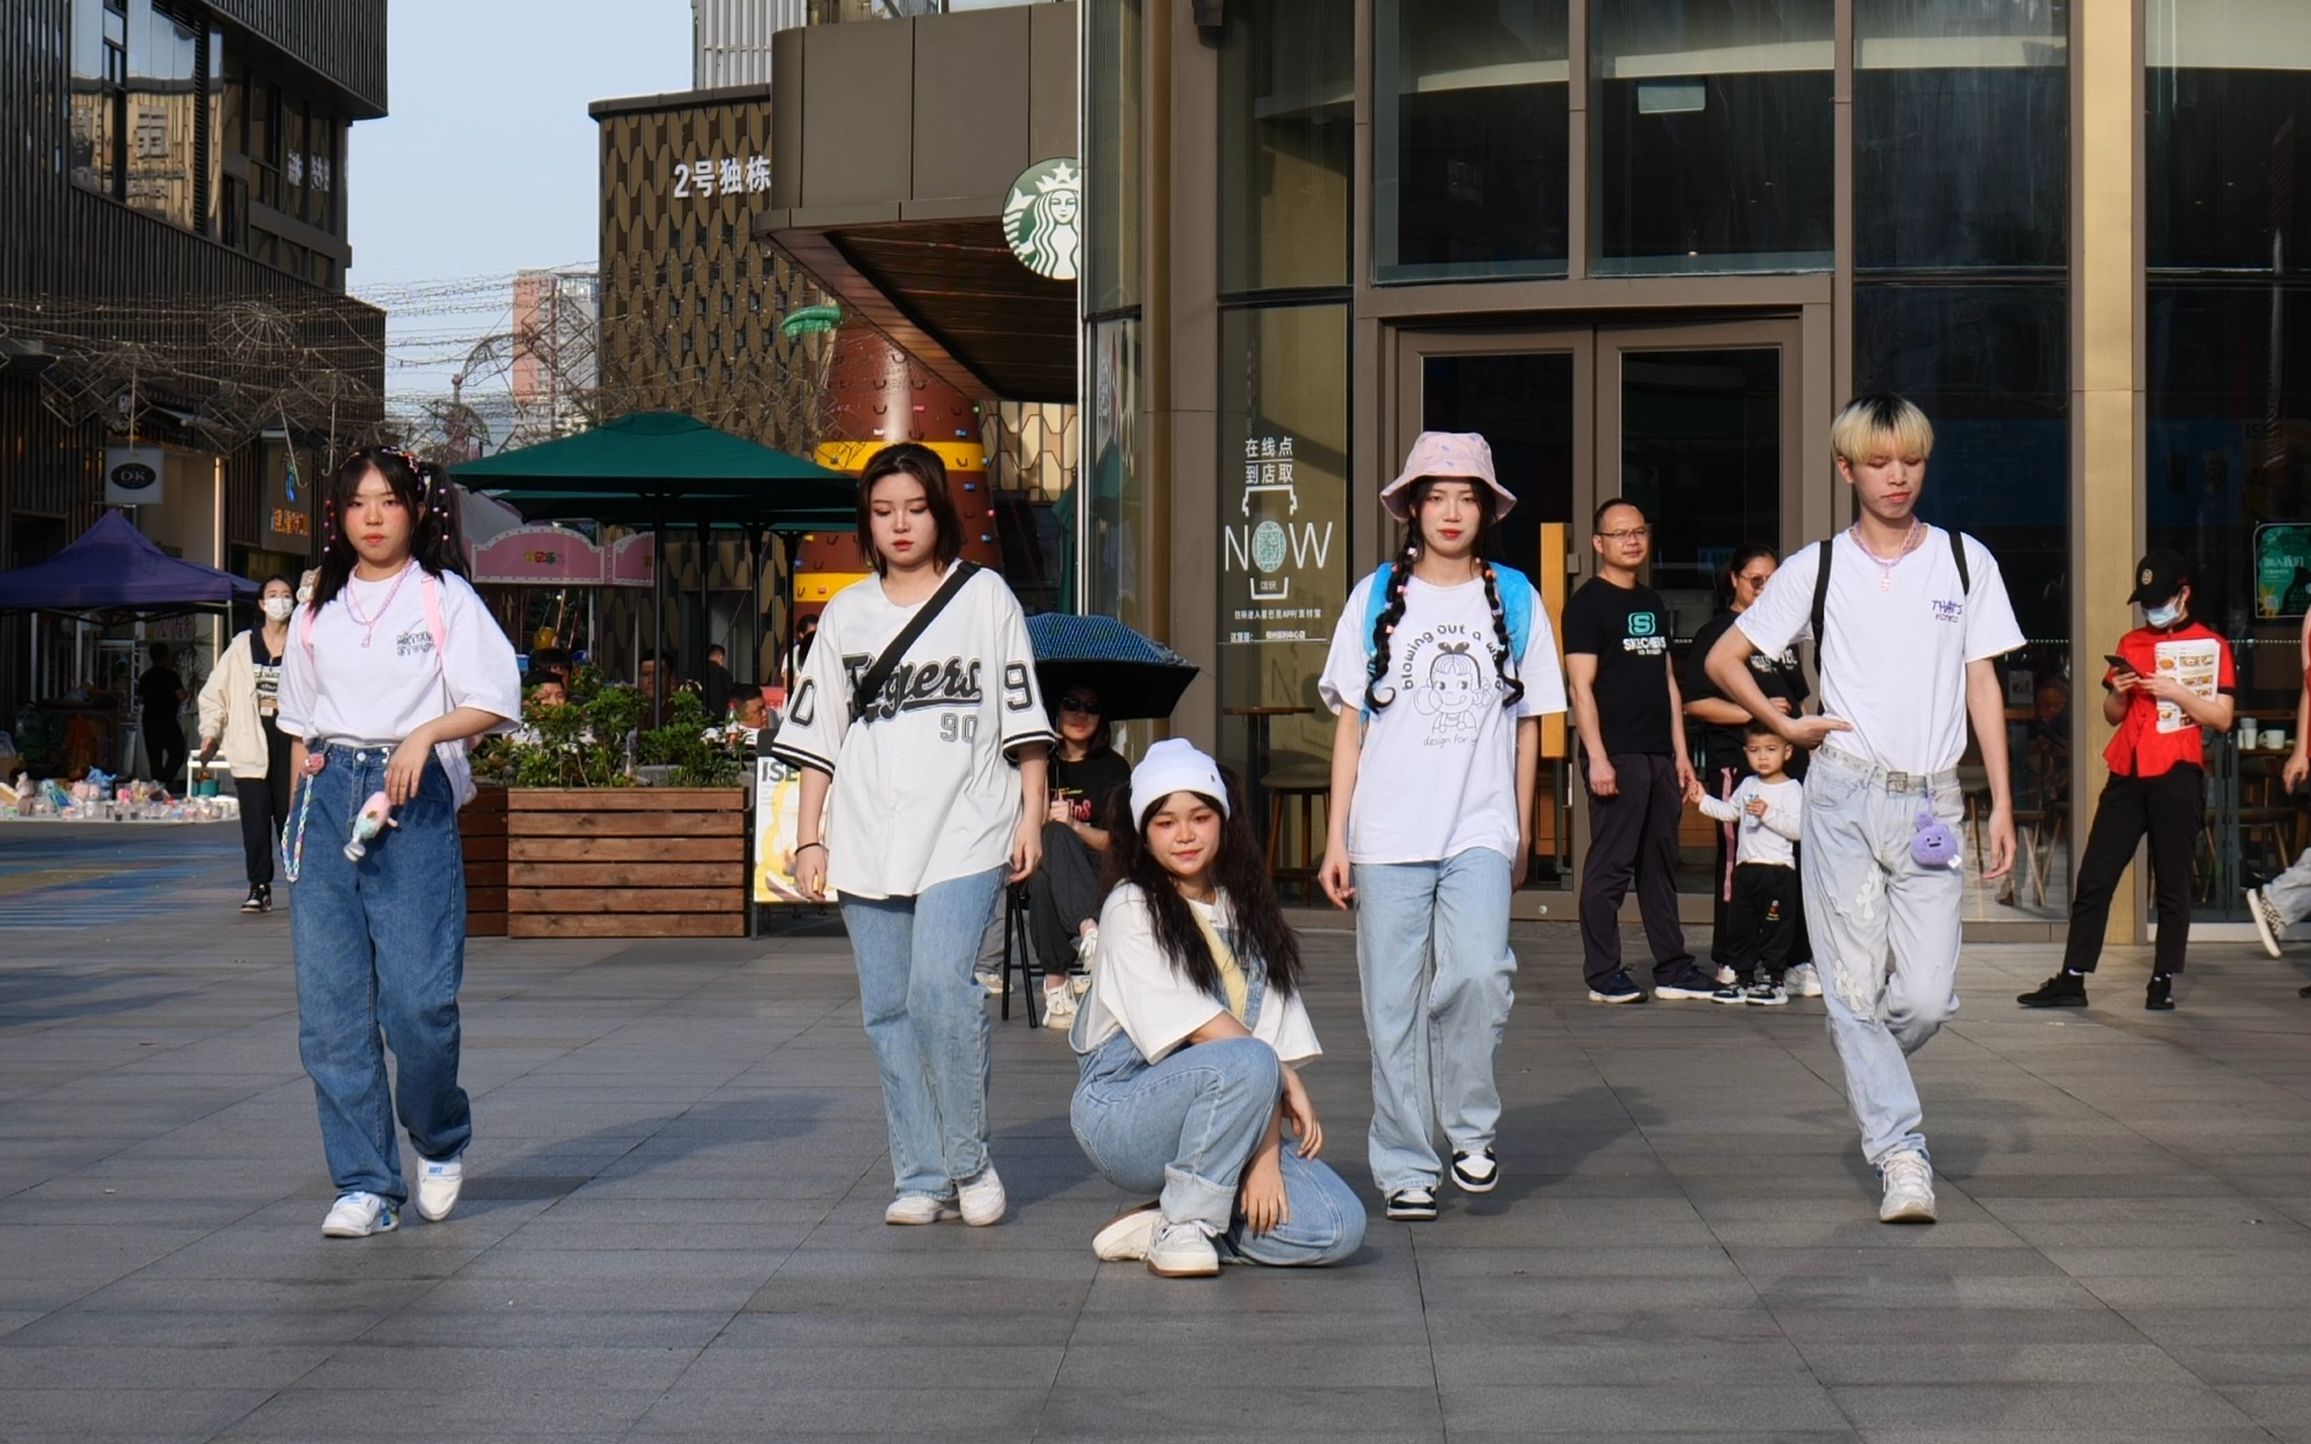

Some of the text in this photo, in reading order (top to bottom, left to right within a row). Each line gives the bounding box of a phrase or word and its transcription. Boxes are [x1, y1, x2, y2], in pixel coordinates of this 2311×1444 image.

[673, 155, 771, 198] 2号独栋
[1244, 436, 1293, 458] 在线点
[1244, 463, 1293, 484] 到店取
[1225, 520, 1333, 573] NOW
[1402, 631, 1435, 692] blowing
[1437, 624, 1465, 635] out
[1472, 631, 1482, 641] a
[840, 655, 983, 724] Tgers
[1004, 662, 1035, 712] 9
[940, 712, 978, 744] 90
